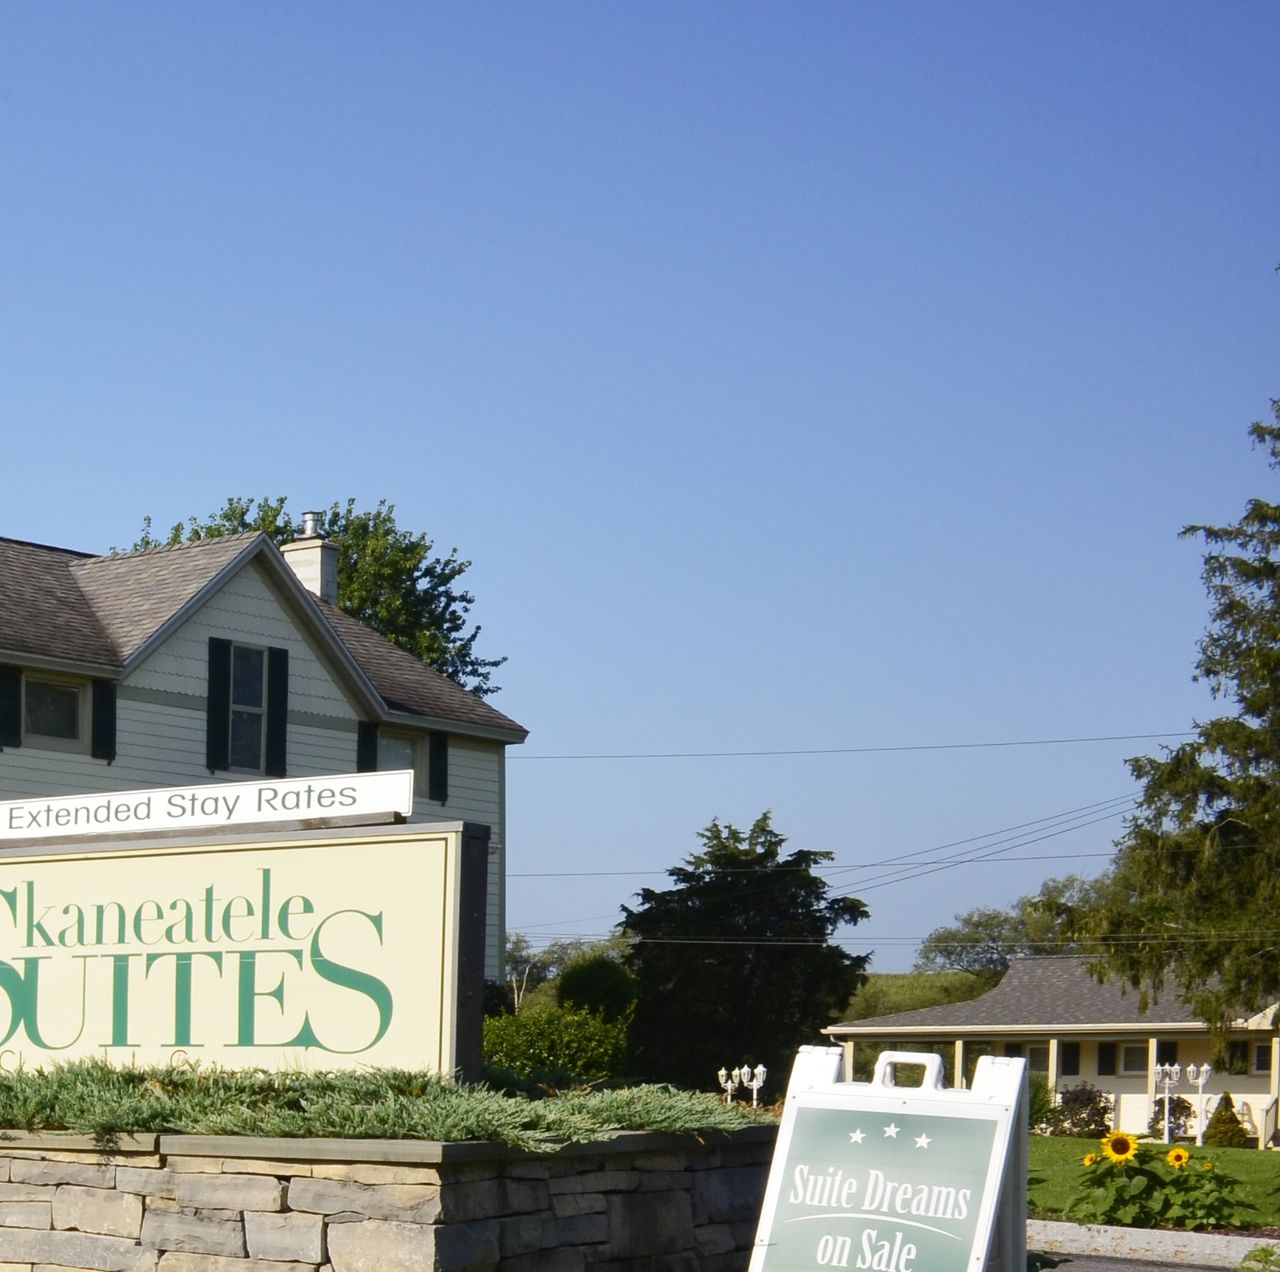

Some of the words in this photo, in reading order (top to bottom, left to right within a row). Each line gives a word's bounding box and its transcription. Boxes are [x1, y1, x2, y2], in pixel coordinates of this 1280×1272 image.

[7, 796, 152, 830] Extended
[166, 792, 241, 820] Stay
[257, 784, 358, 812] Rates
[788, 1164, 858, 1209] Suite
[861, 1169, 972, 1220] Dreams
[816, 1234, 851, 1268] on
